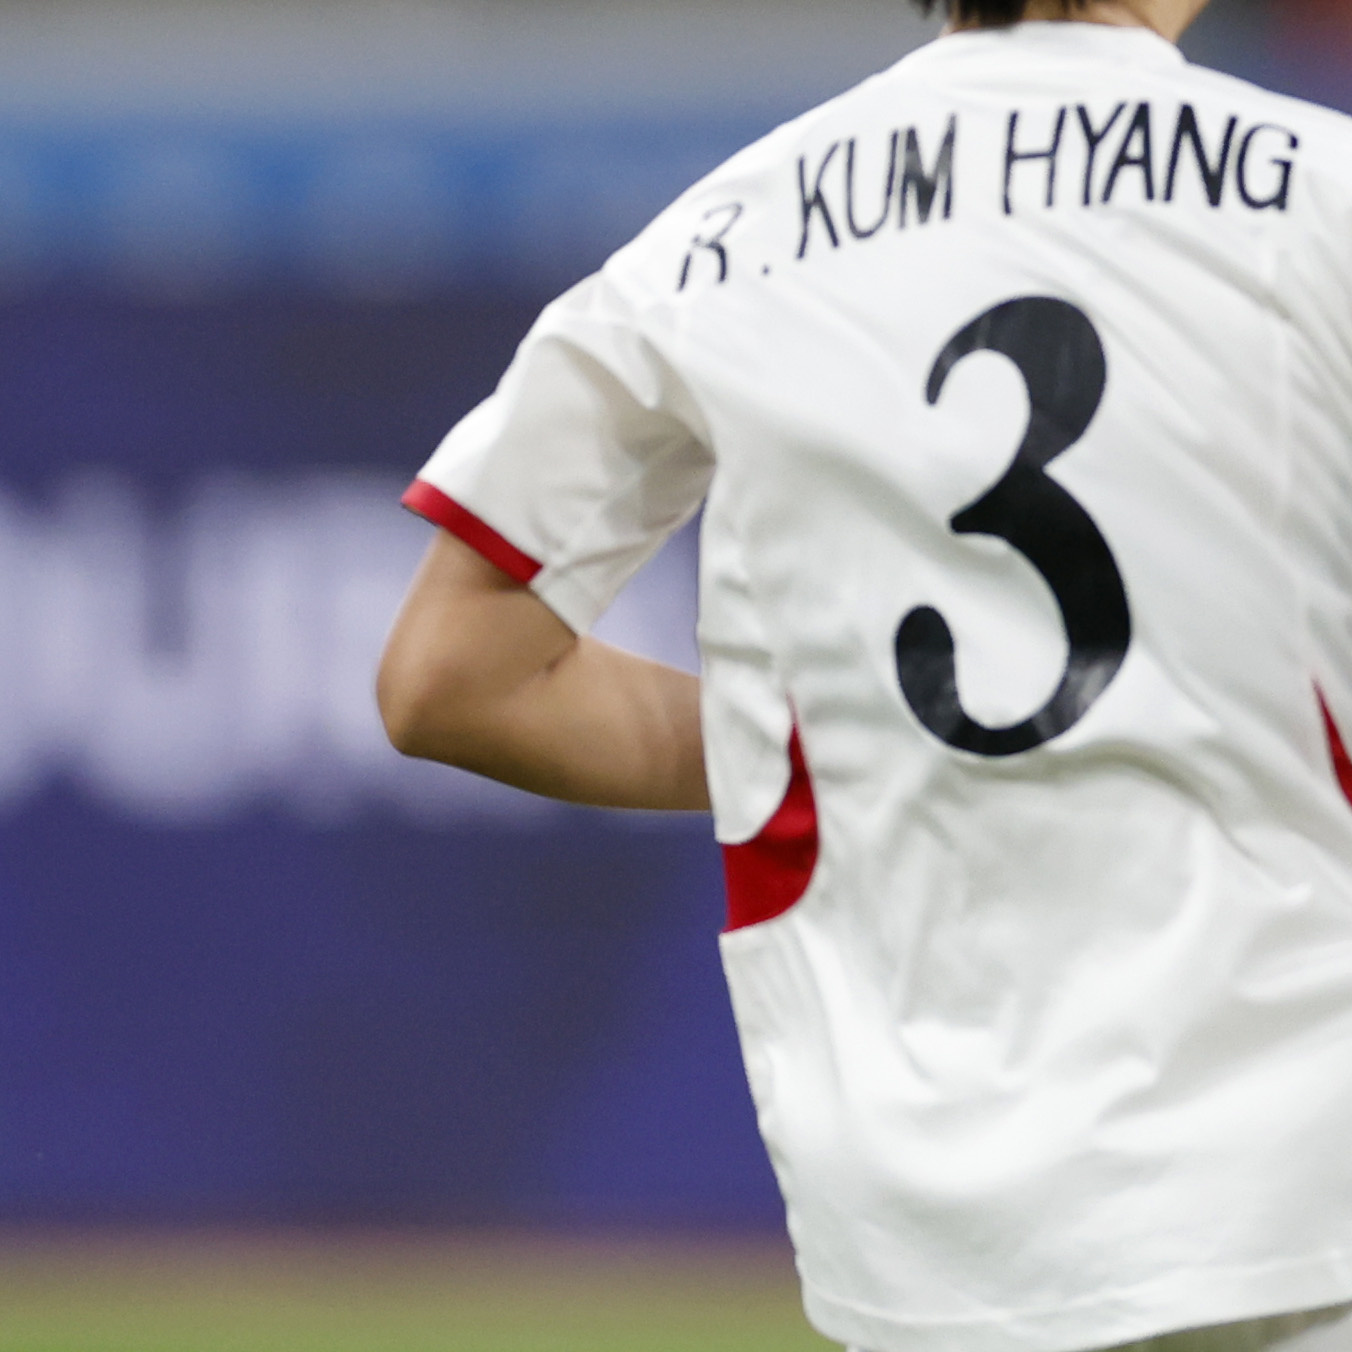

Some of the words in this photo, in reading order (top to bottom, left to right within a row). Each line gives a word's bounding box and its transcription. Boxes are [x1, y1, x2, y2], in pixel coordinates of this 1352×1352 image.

[676, 202, 771, 292] R.
[796, 112, 957, 260] KUM
[1002, 101, 1299, 215] HYANG
[895, 295, 1131, 757] 3
